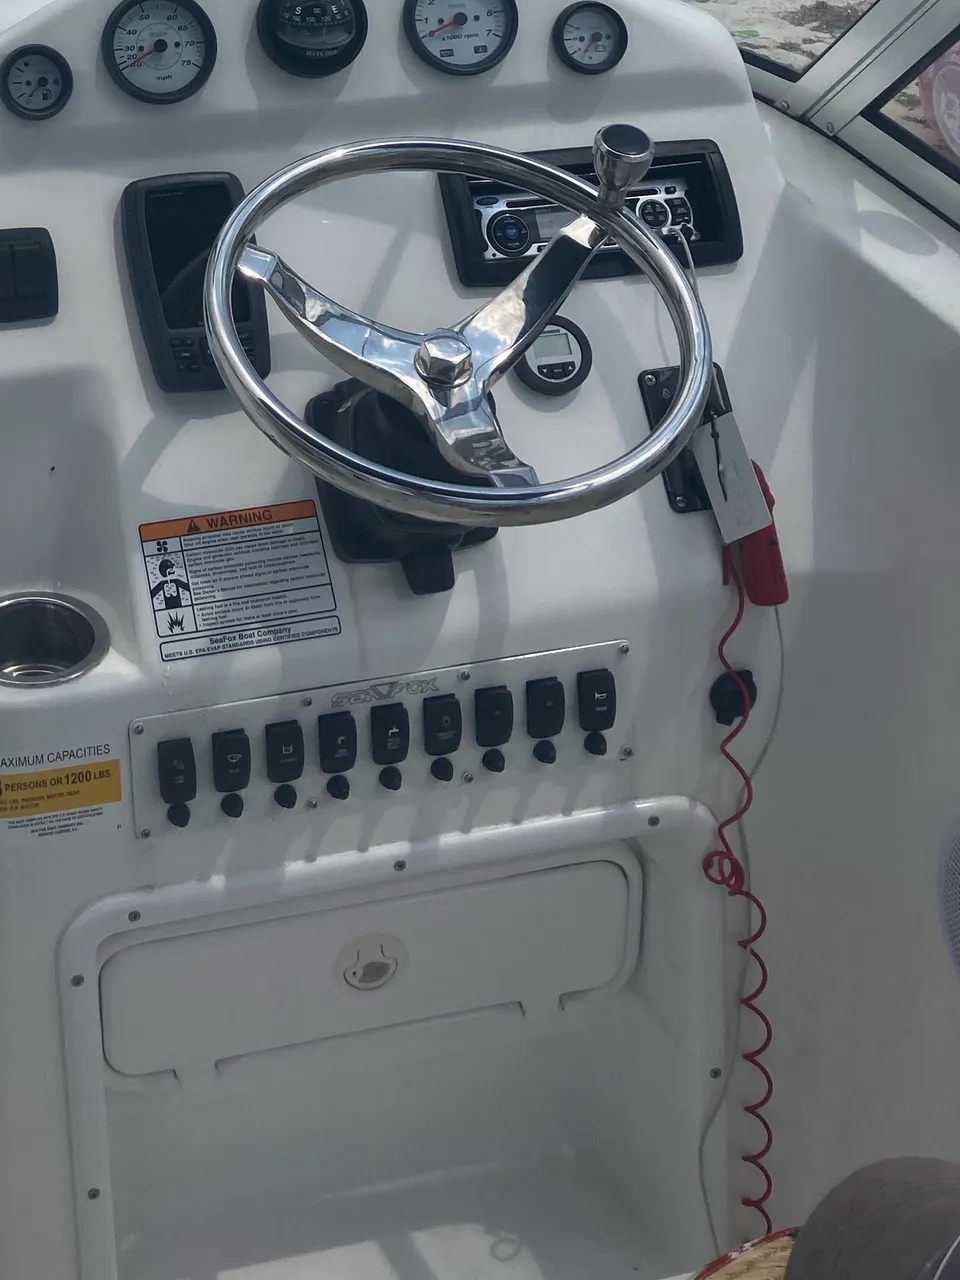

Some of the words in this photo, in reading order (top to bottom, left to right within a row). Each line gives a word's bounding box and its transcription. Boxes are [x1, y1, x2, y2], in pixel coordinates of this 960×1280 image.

[295, 7, 302, 15] S
[306, 49, 338, 57] RITCHIE
[207, 510, 273, 528] WARNING
[209, 635, 236, 644] SeaFox
[238, 631, 255, 640] Boat
[257, 626, 292, 638] Company
[222, 640, 254, 649] STANDARDS
[273, 633, 300, 641] CERTIFIED
[302, 627, 338, 636] COMPONENTS
[47, 744, 111, 763] CAPACITIES
[5, 778, 48, 792] PERSONS
[50, 777, 63, 787] OR
[65, 770, 92, 785] 1200
